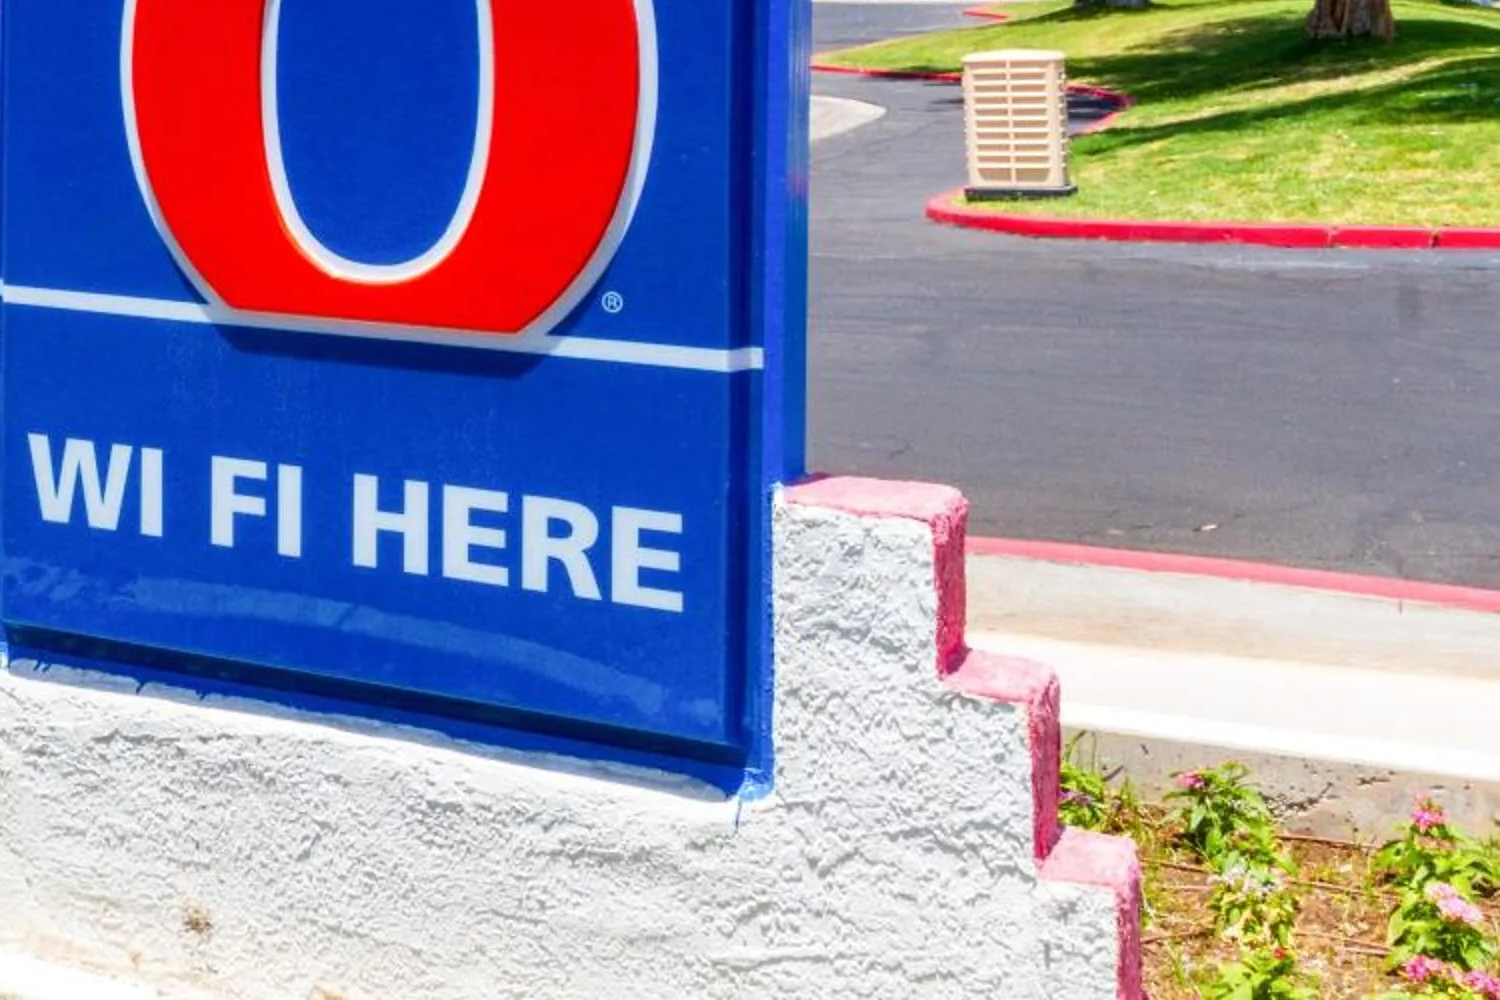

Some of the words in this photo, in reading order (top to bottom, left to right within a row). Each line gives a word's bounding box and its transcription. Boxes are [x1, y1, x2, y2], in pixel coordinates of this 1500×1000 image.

[27, 432, 163, 537] WI
[210, 455, 302, 558] FI
[352, 473, 684, 613] HERE
